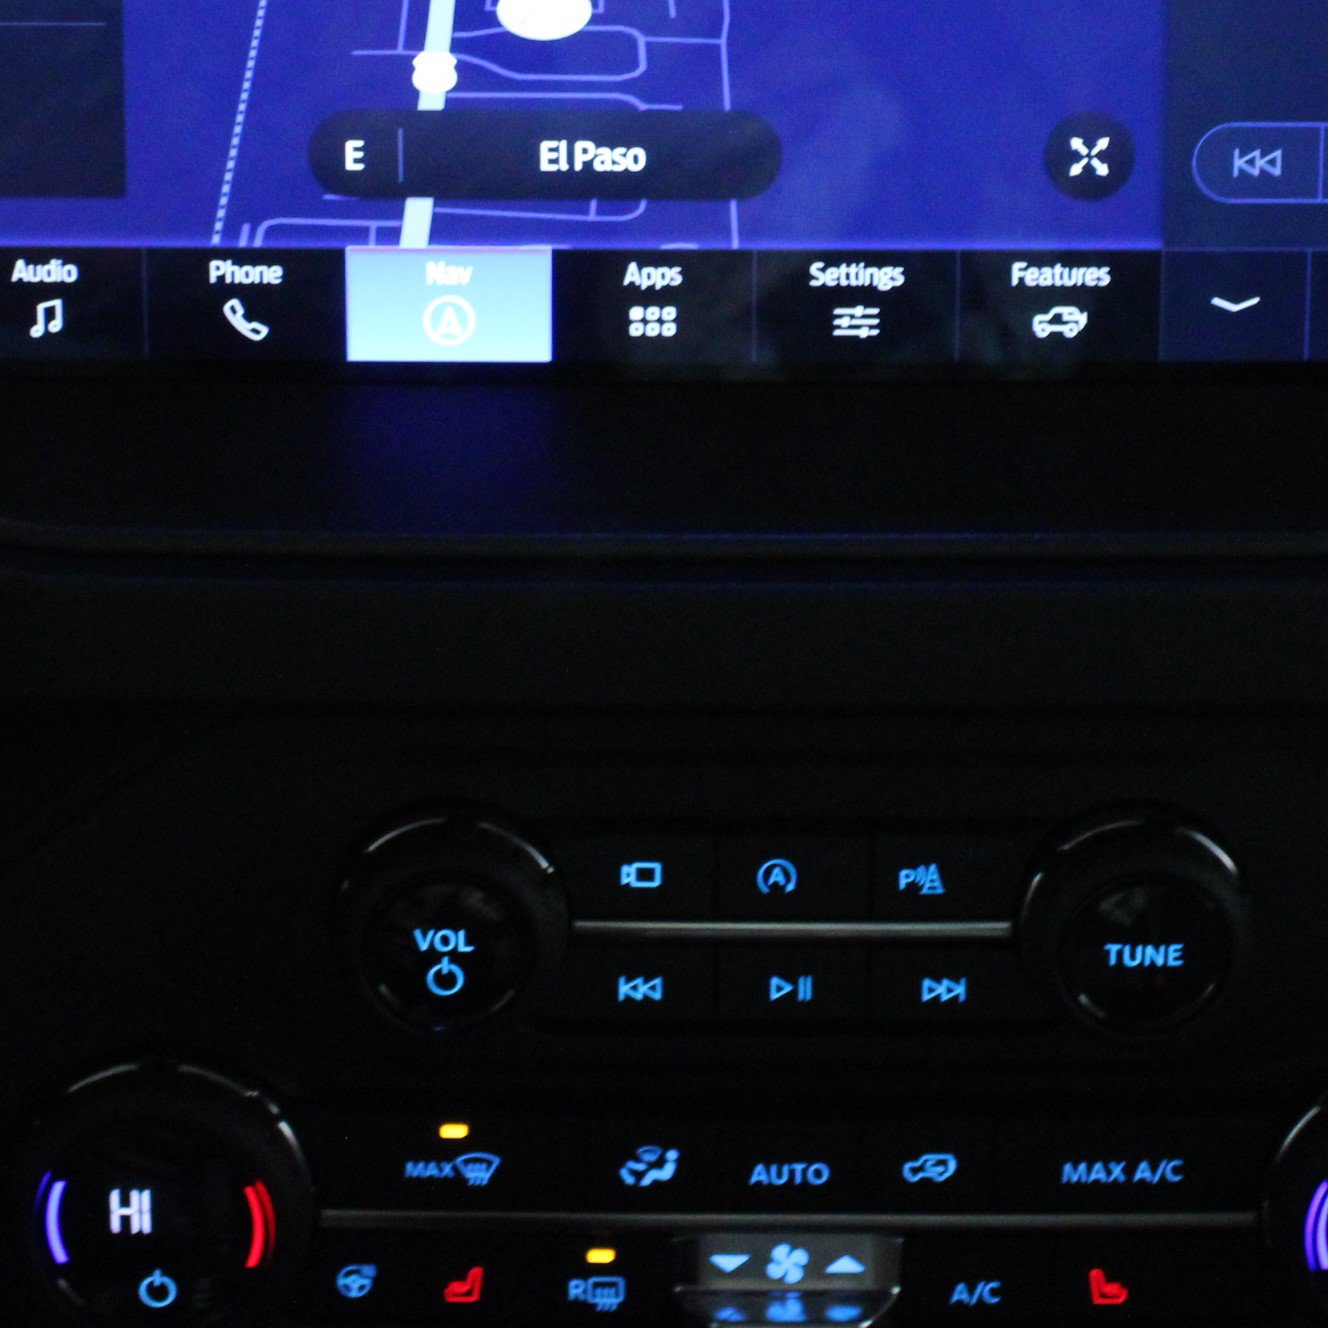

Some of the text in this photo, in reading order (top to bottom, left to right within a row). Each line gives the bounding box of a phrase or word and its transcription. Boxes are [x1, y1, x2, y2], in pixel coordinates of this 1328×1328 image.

[344, 140, 364, 171] E
[539, 140, 647, 172] El Paso
[11, 259, 79, 284] Audio
[208, 260, 283, 285] Phone
[425, 260, 473, 286] Nav
[623, 261, 683, 290] Apps
[808, 262, 905, 291] Settings
[1010, 262, 1111, 287] Features
[413, 928, 474, 953] VOL
[1104, 942, 1185, 968] TUNE
[405, 1159, 455, 1180] MAX
[748, 1162, 830, 1186] AUTO
[1061, 1160, 1183, 1185] MAX A/C
[108, 1188, 152, 1235] HI
[950, 1281, 1001, 1305] A/C
